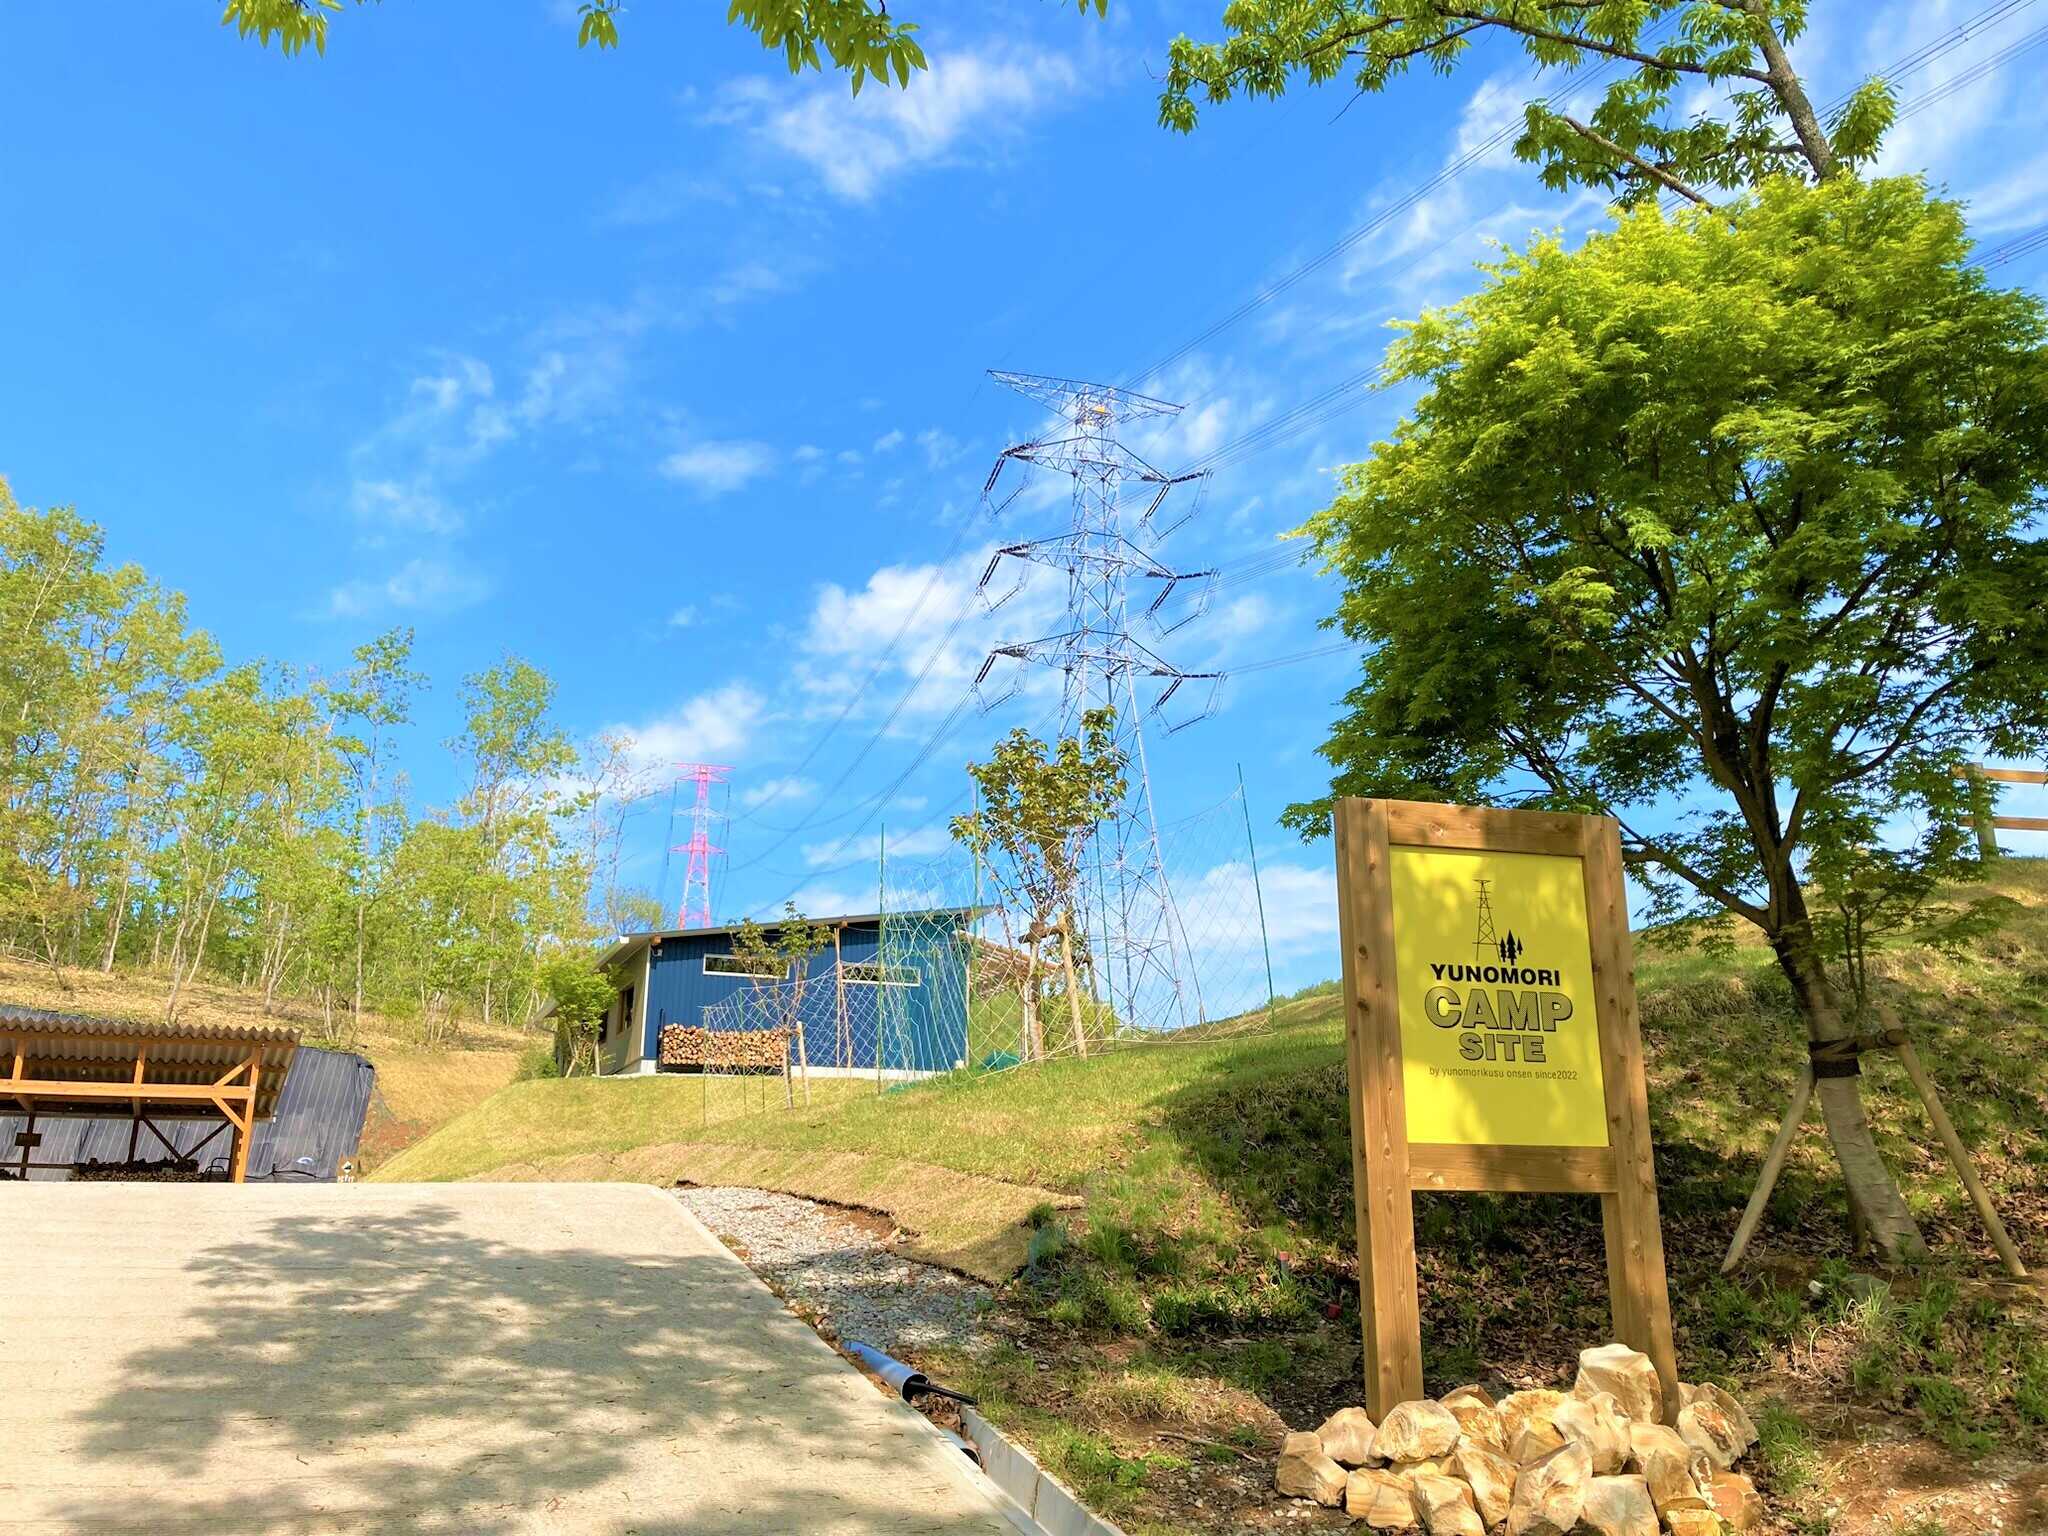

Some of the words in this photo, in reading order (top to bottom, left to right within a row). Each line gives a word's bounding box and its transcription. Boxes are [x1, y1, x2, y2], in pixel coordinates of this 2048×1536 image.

[1430, 963, 1561, 986] YUNOMORI
[1425, 985, 1573, 1032] CAMP
[1459, 1031, 1547, 1063] SITE
[1429, 1066, 1440, 1078] by
[1506, 1070, 1532, 1079] onsen
[1535, 1069, 1578, 1081] since2022
